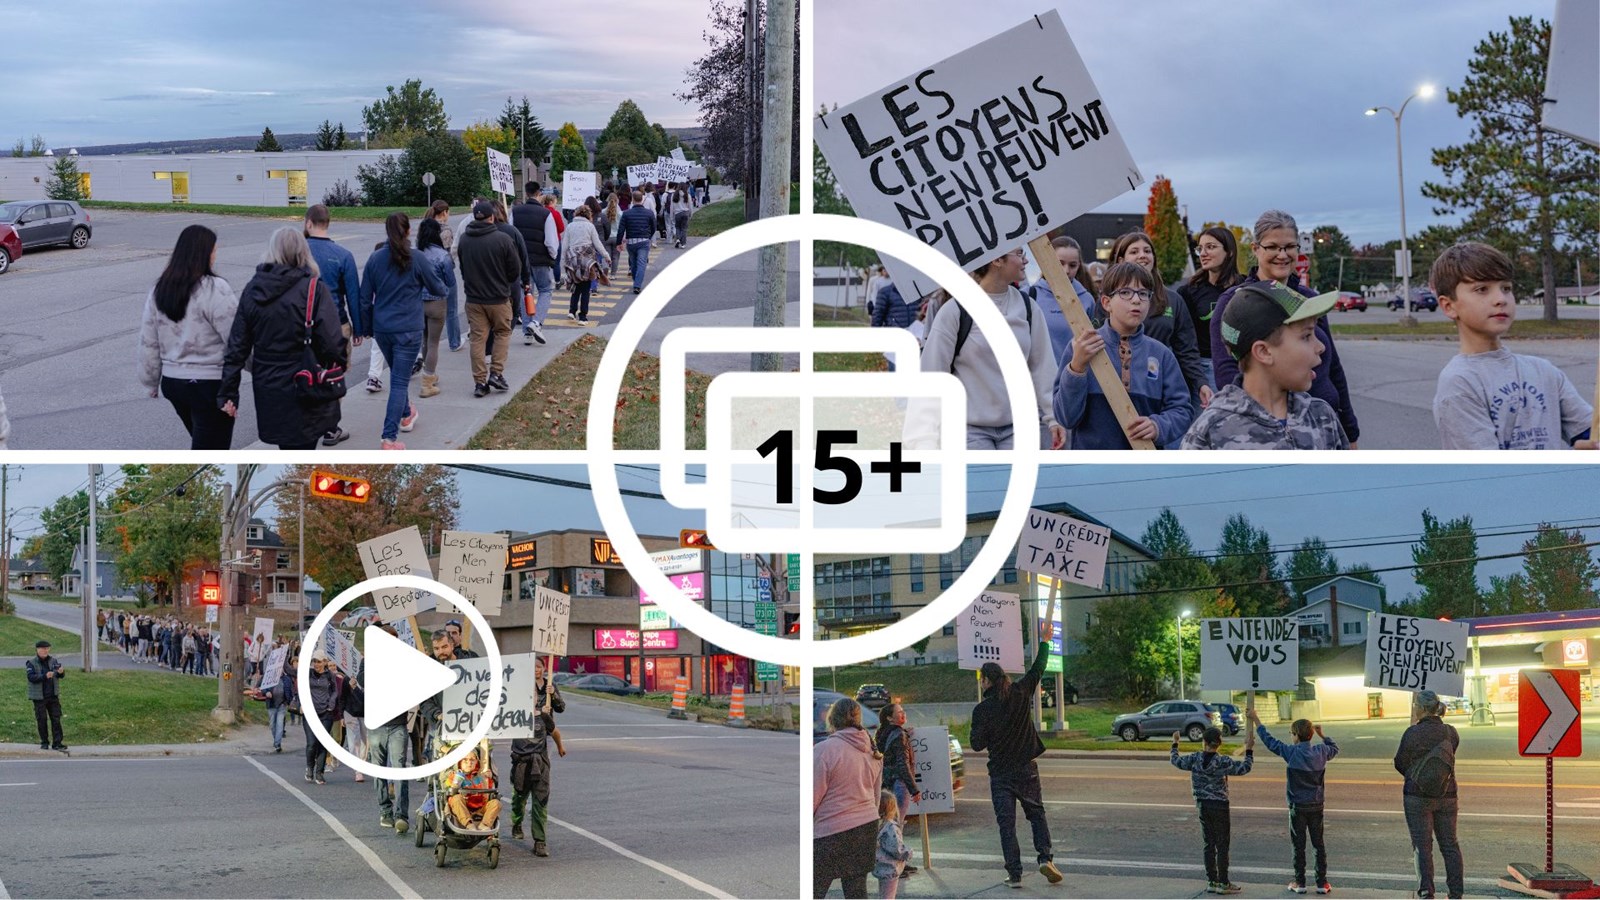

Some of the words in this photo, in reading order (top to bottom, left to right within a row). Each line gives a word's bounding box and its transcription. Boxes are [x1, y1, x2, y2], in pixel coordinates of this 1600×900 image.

[841, 69, 954, 158] LES
[895, 161, 983, 229] N'EN
[978, 100, 1109, 193] PEUVENT
[1030, 514, 1056, 533] UN
[1059, 522, 1109, 547] CRÉDIT
[369, 542, 402, 565] Les
[444, 534, 466, 549] Les
[469, 538, 504, 553] Citoyens
[512, 542, 534, 553] VACHON
[1055, 537, 1075, 553] DE
[1028, 544, 1088, 579] TAXE
[454, 567, 495, 584] Peuvent
[203, 588, 218, 600] 20
[539, 592, 551, 610] UN
[547, 615, 557, 632] DE
[1208, 617, 1297, 642] ENTENDEZ
[1380, 617, 1420, 637] LES
[539, 628, 566, 649] TAXE
[975, 631, 993, 643] Plus
[1226, 643, 1287, 665] VOUS
[1379, 651, 1411, 668] N'EN
[1413, 655, 1466, 675] PEUVENT
[476, 664, 515, 682] vet
[1251, 664, 1259, 688] !
[1379, 664, 1428, 690] PLUS!
